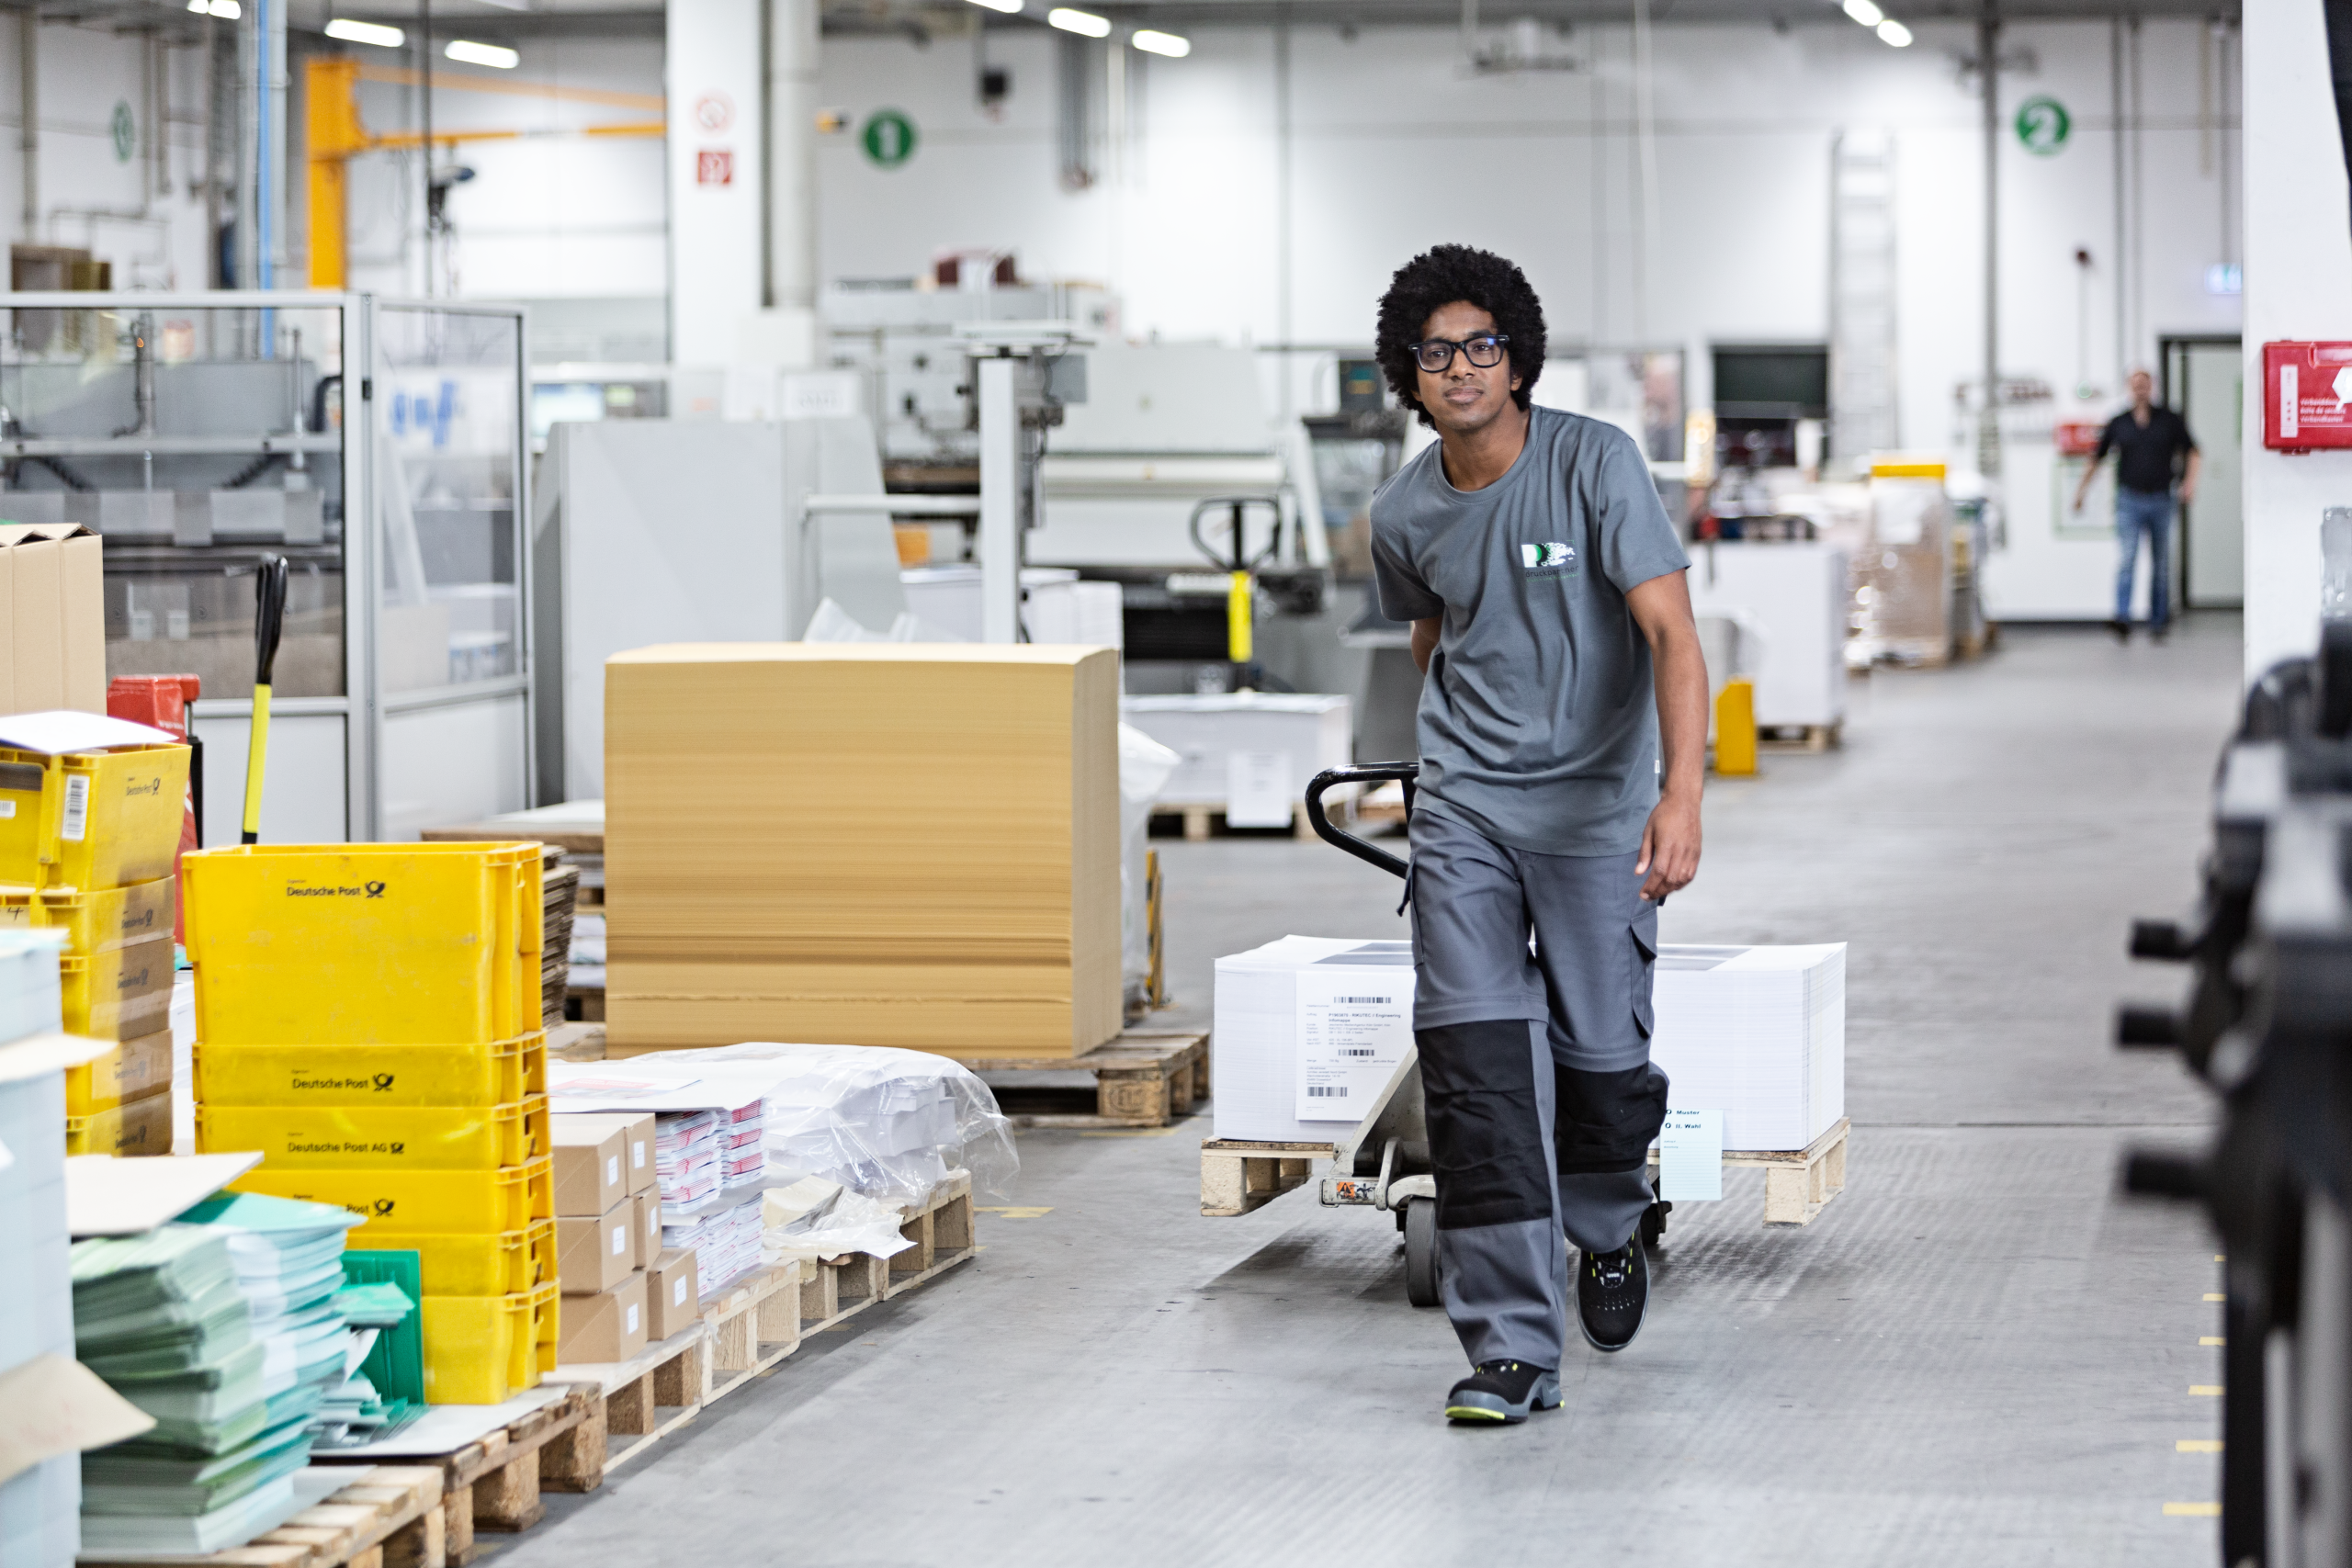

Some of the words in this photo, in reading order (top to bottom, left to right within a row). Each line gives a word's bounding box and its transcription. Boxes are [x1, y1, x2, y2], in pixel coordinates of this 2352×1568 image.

[2026, 107, 2057, 147] 2
[287, 886, 335, 897] Deutsche
[338, 886, 361, 896] Post
[292, 1078, 343, 1089] Deutsche
[345, 1078, 368, 1089] Post
[288, 1142, 341, 1153] Deutsche
[344, 1142, 368, 1152] Post
[371, 1142, 388, 1152] AG
[346, 1203, 368, 1213] Post
